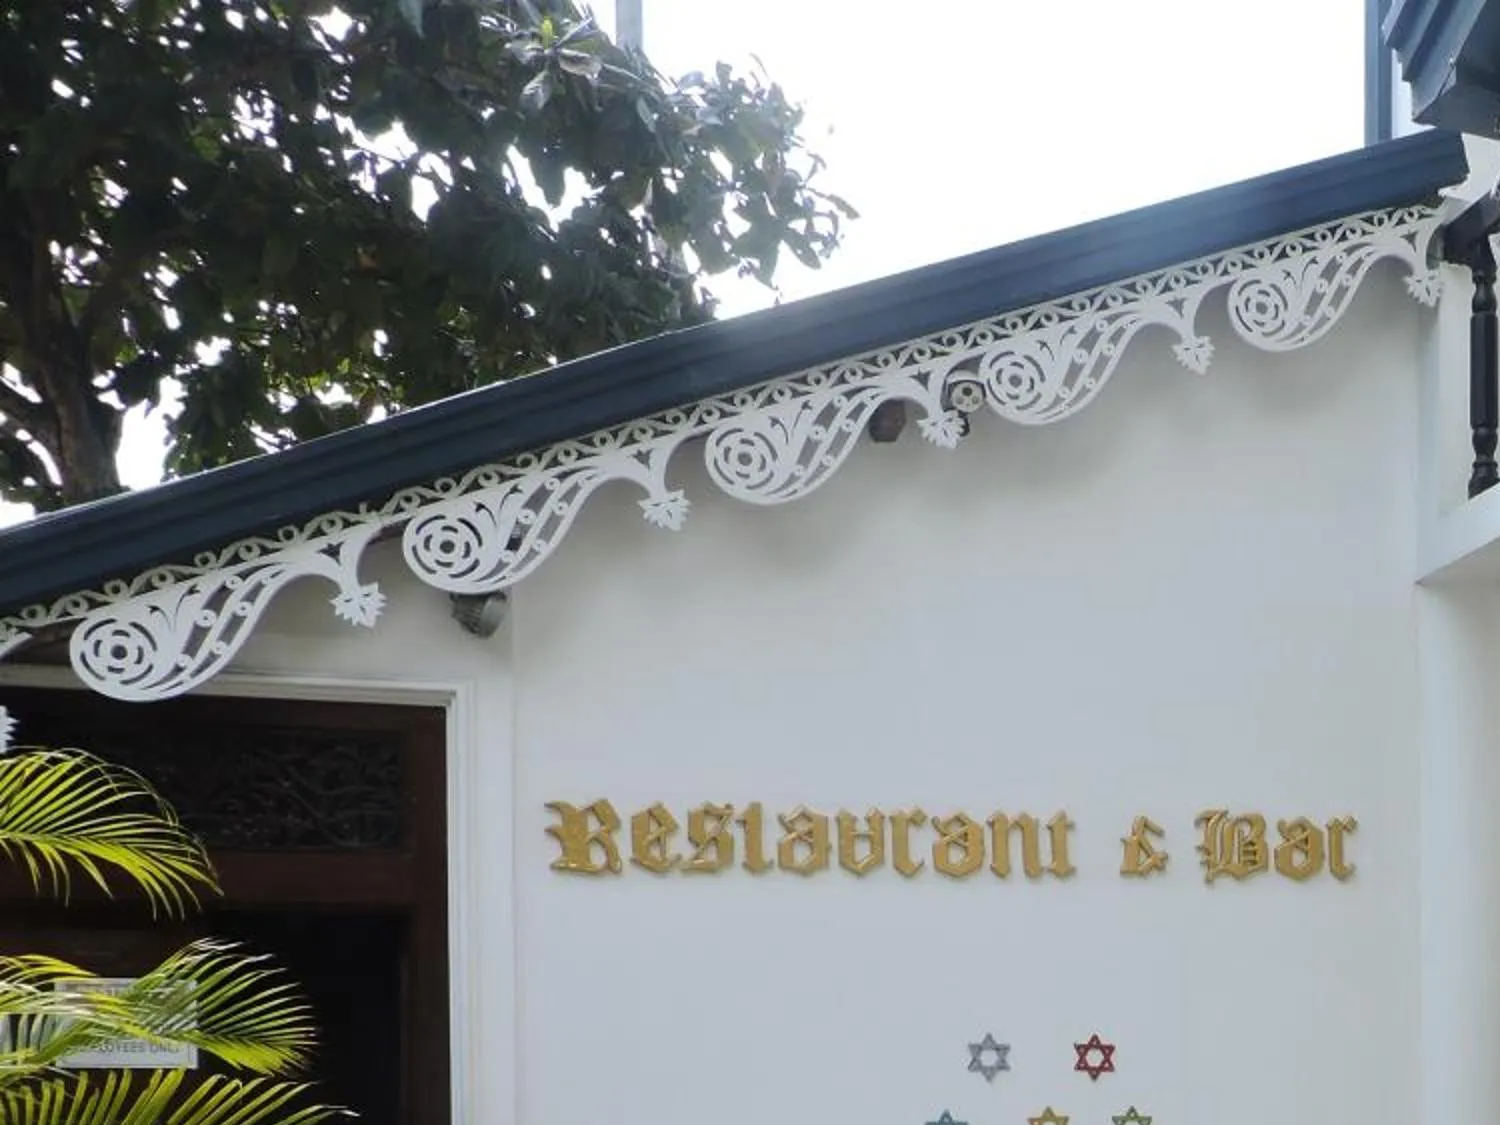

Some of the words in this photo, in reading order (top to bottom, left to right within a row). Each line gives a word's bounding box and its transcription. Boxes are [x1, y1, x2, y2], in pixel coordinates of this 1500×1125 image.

[544, 798, 1075, 879] Restaurant
[1120, 814, 1168, 877] &
[1195, 807, 1358, 883] Bar
